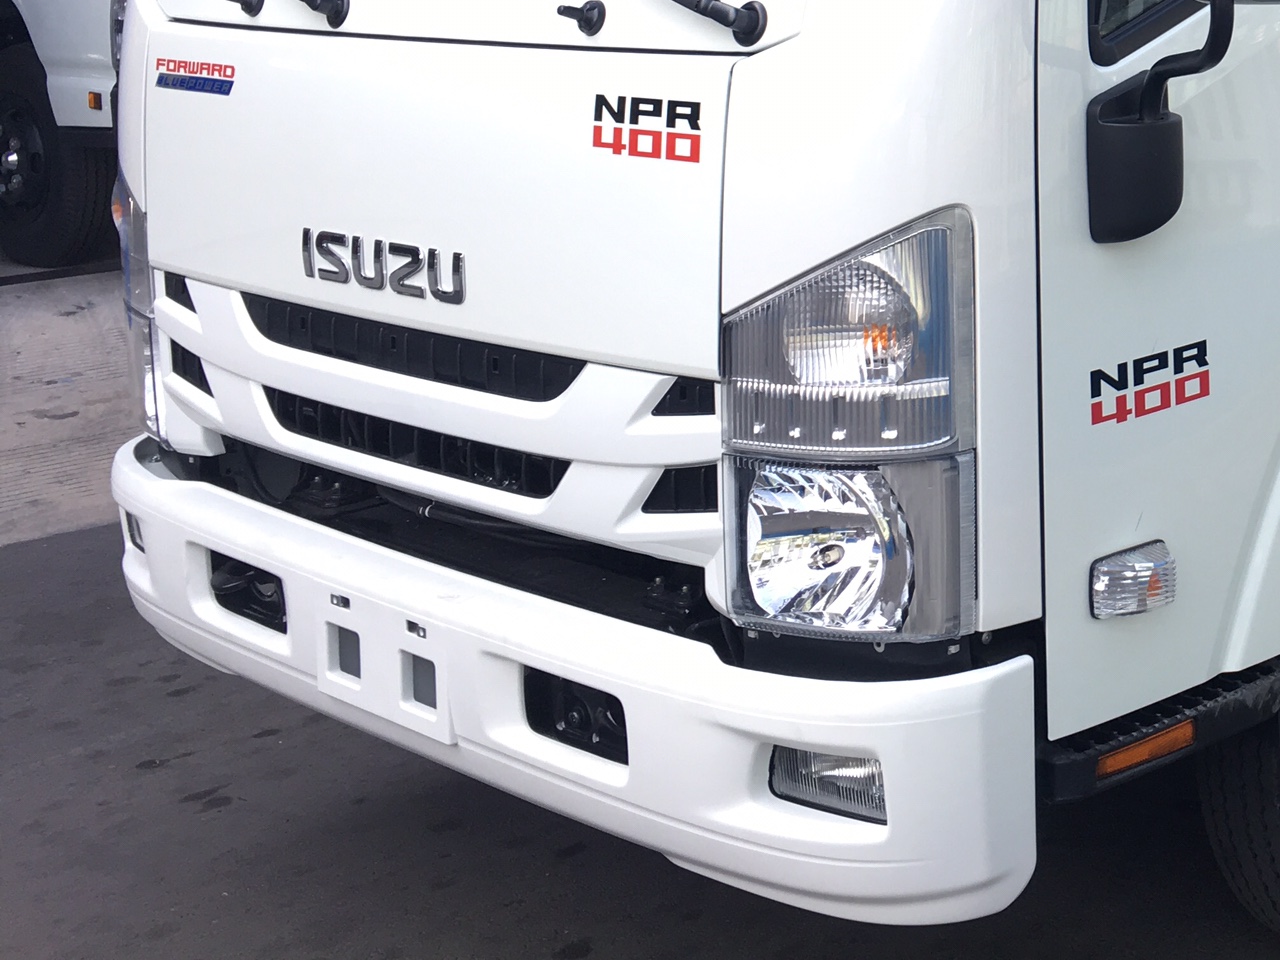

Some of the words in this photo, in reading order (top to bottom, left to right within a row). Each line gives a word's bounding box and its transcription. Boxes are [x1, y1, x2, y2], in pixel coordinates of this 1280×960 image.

[156, 58, 236, 79] FORWARD
[594, 94, 702, 131] NPR
[592, 125, 701, 163] 400
[303, 227, 467, 306] ISUZU
[1090, 339, 1210, 400] NPR
[1091, 369, 1211, 426] 400
